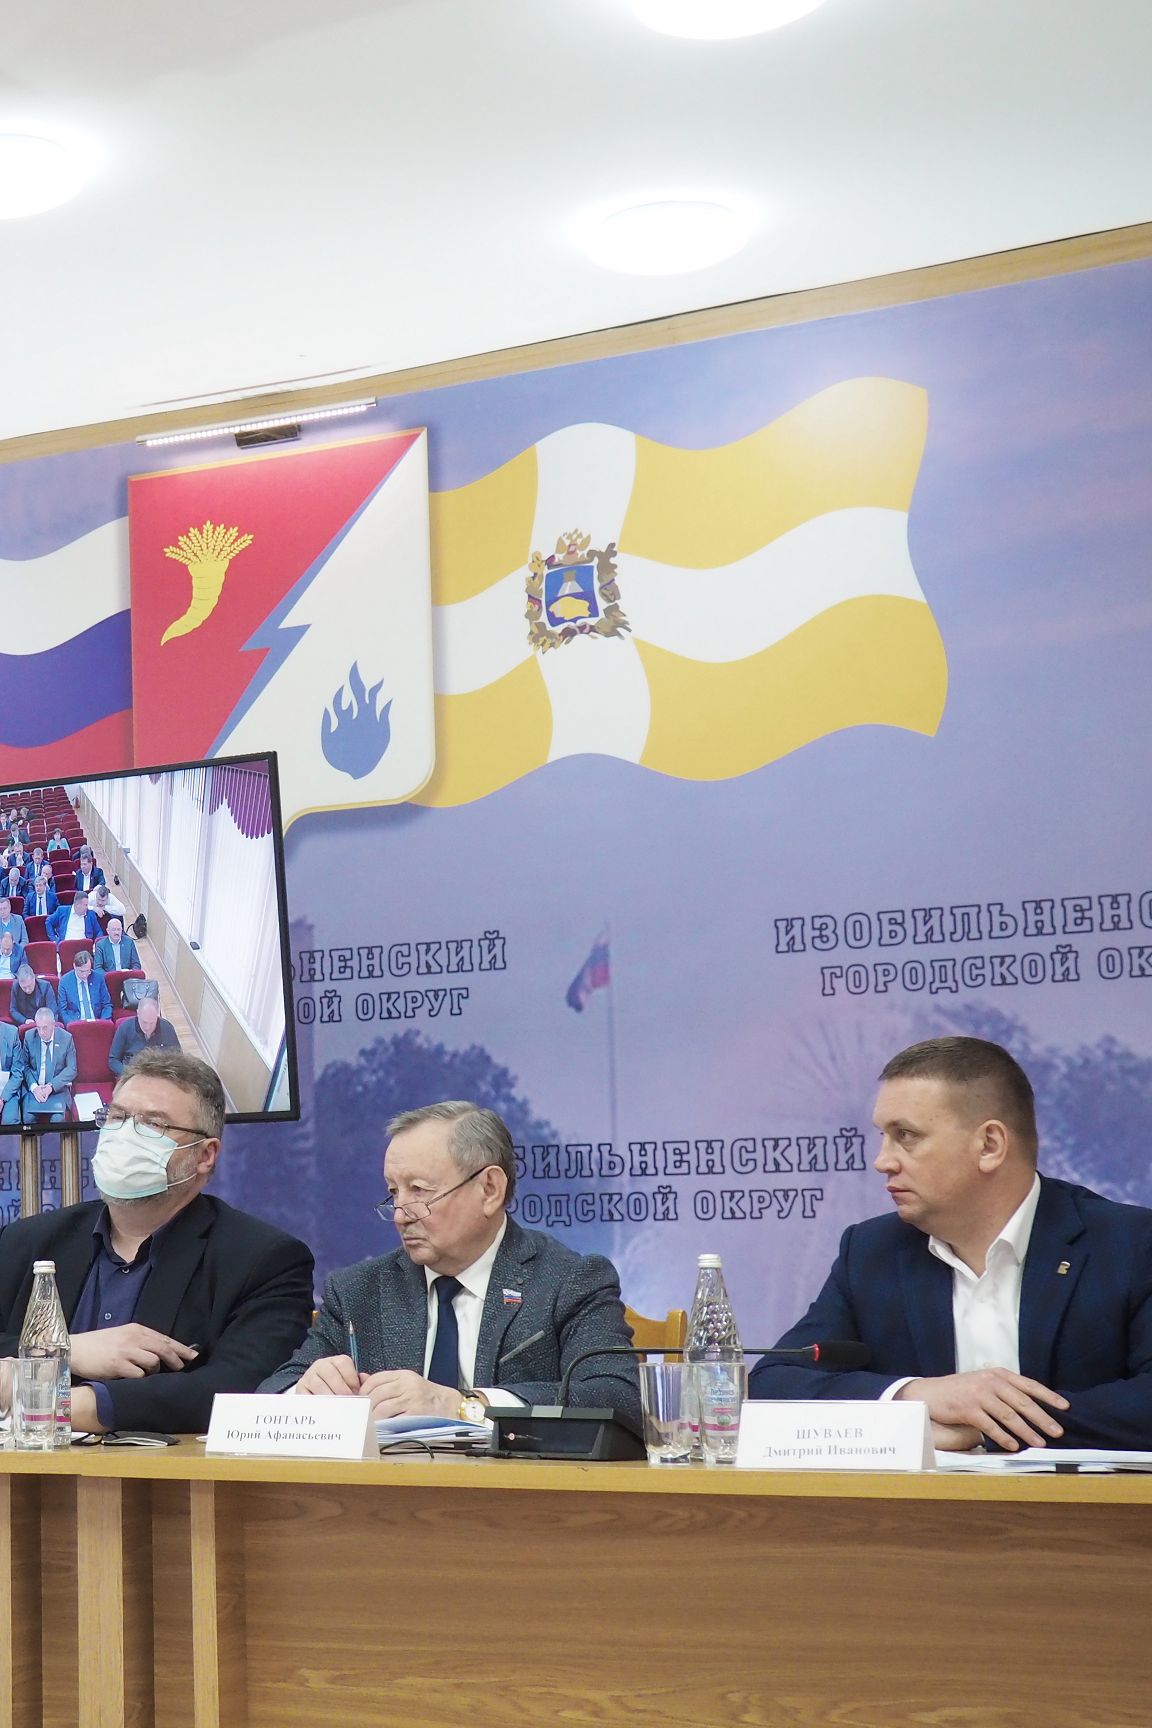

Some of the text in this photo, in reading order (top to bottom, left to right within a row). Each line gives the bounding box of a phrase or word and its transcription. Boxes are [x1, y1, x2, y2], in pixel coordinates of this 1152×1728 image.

[291, 930, 506, 982] НЕНСКИЙ
[821, 944, 1080, 996] ГОРОДСКОЙ
[355, 987, 469, 1021] ОКРУГ
[694, 1188, 824, 1220] ОКРУГ
[255, 1414, 316, 1425] ГОНТАРЬ
[226, 1429, 342, 1442] Юрий Афанасьевич
[796, 1427, 864, 1439] ШУВАЕВ
[762, 1444, 896, 1459] Дмитрий Иванович
